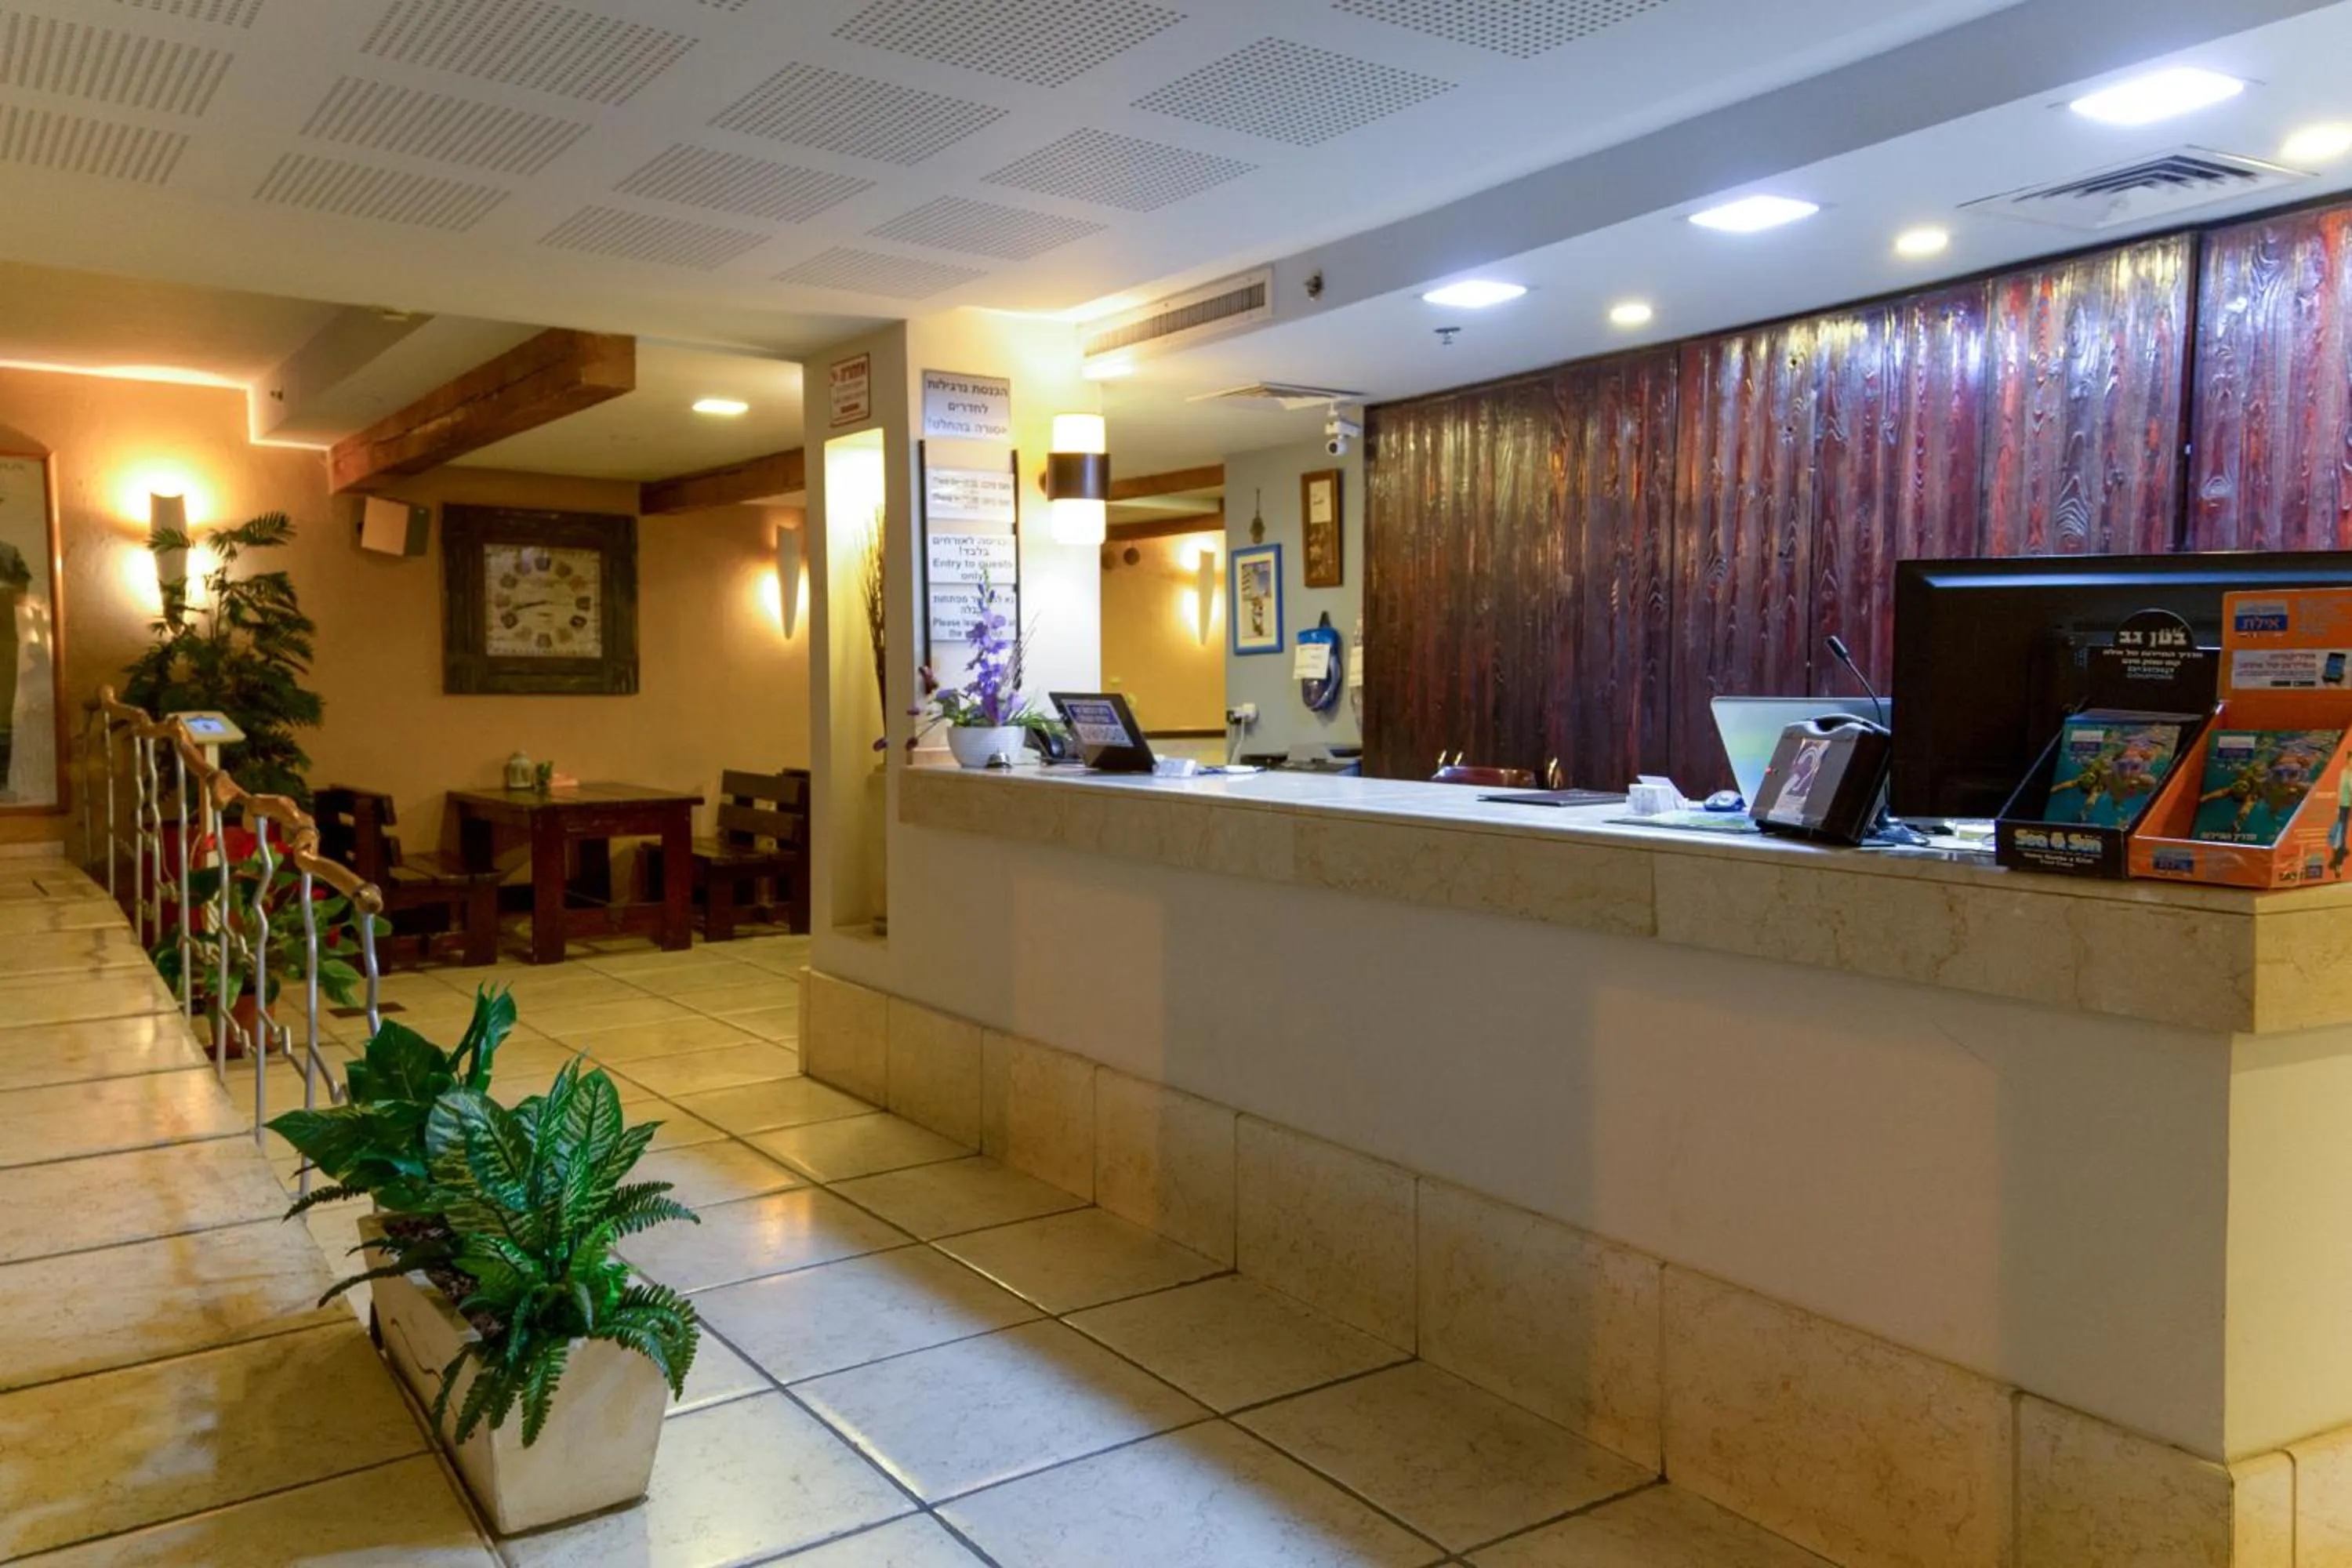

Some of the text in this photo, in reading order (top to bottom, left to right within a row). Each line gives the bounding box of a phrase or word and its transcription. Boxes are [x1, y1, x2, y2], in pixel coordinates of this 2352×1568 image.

[947, 401, 989, 414] לחדרים
[932, 559, 962, 569] Entry
[978, 560, 1013, 569] guests
[933, 618, 960, 626] Please
